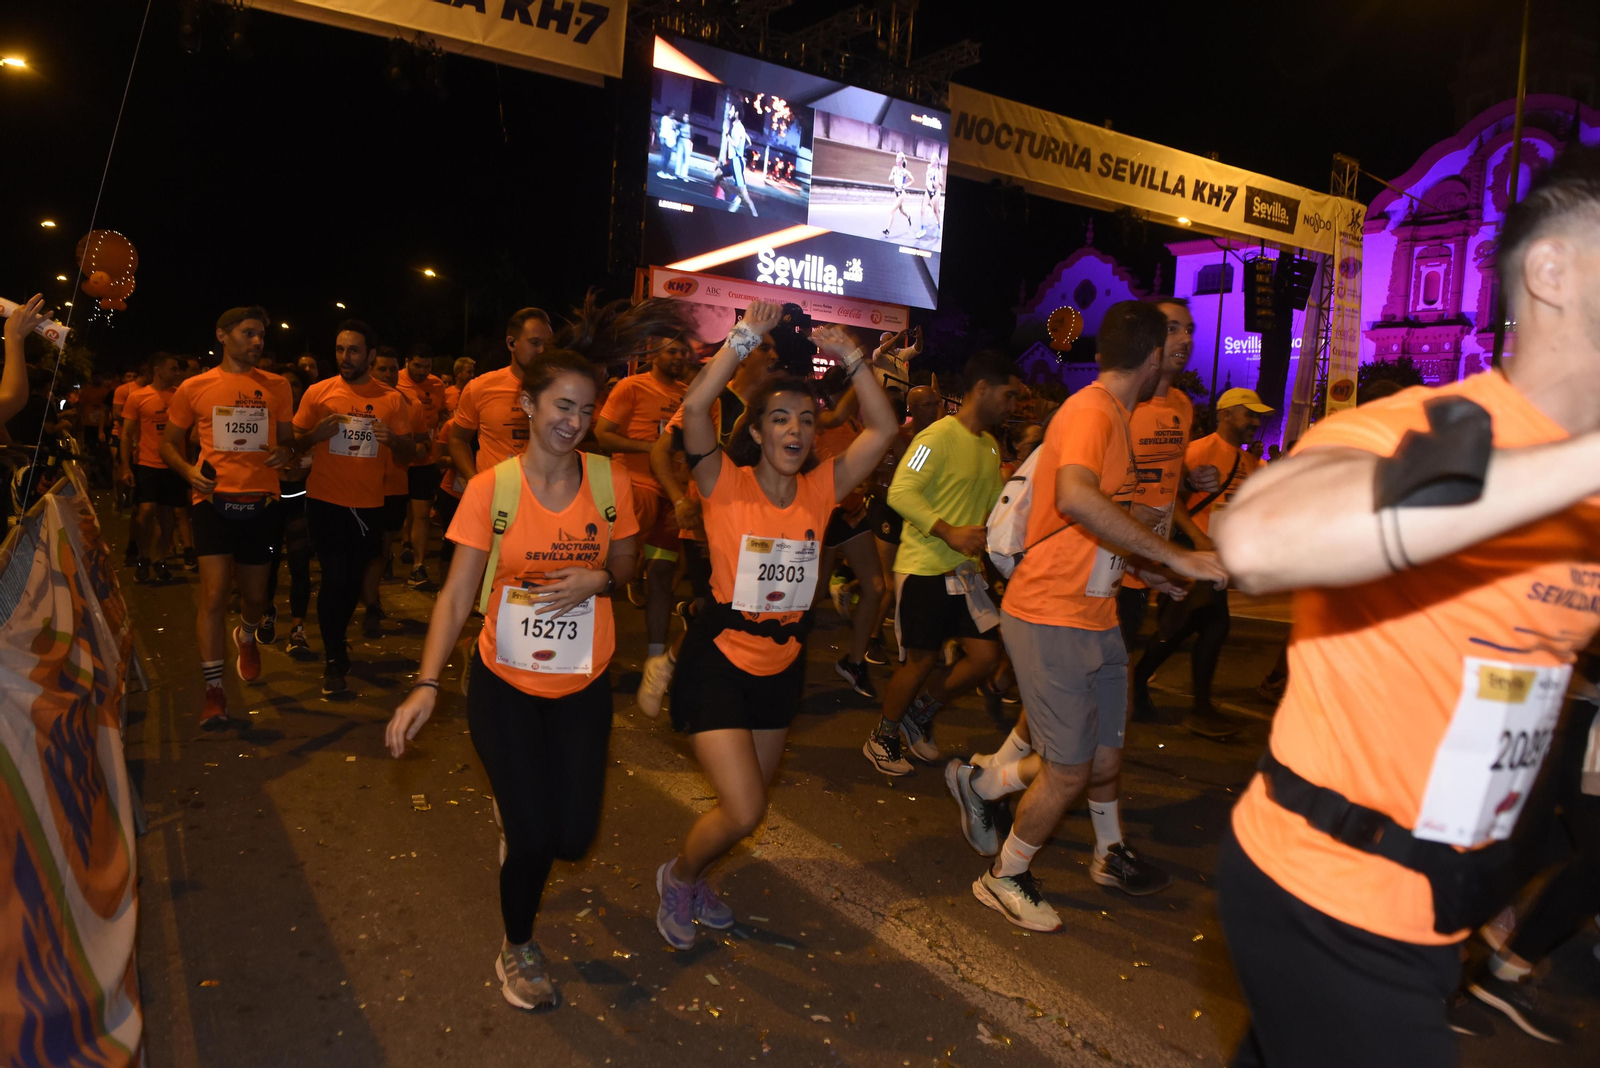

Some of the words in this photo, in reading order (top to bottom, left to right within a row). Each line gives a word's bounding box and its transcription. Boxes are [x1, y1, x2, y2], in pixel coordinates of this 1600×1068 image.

[954, 111, 1092, 173] NOCTURNA
[1097, 152, 1186, 198] SEVILLA
[706, 287, 721, 295] ABC
[225, 422, 258, 434] 12550
[342, 428, 372, 441] 12556
[551, 542, 600, 551] NOCTURNA
[525, 551, 574, 561] SEVILLA
[757, 563, 805, 583] 20303
[520, 617, 578, 640] 15273
